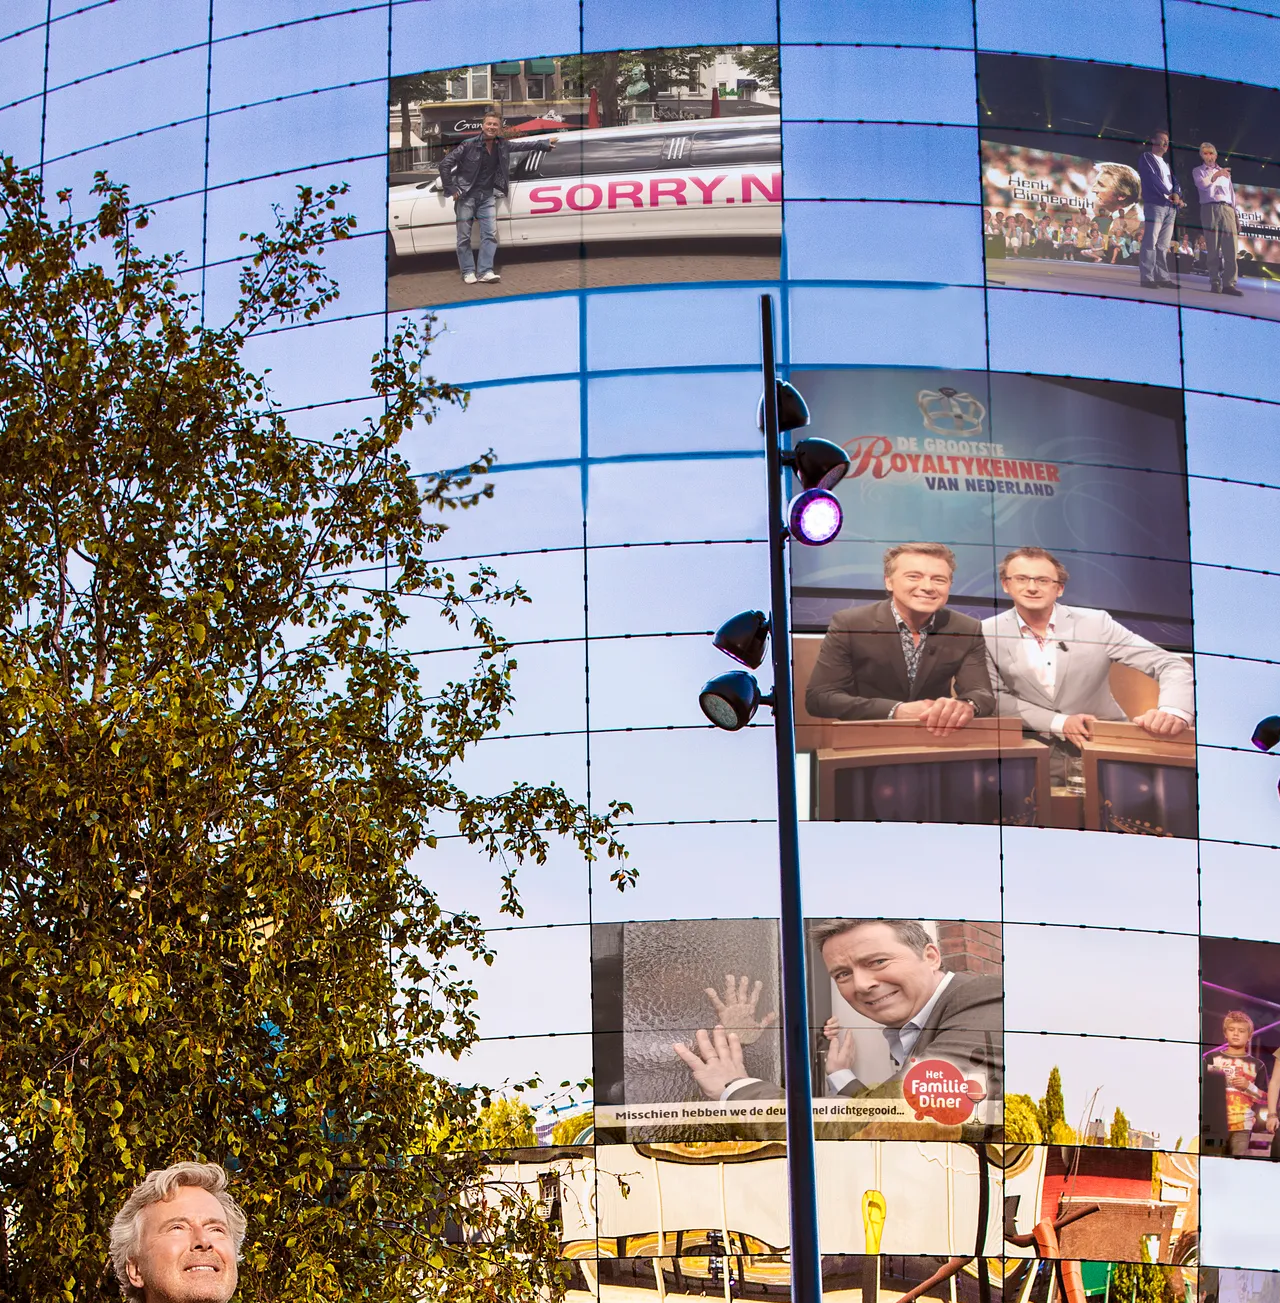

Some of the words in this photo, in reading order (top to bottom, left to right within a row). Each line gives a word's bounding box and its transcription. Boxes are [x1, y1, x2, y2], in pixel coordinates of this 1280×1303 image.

[454, 119, 484, 132] Gran
[1008, 175, 1050, 191] Henk
[528, 172, 782, 215] SORRY.N
[1013, 187, 1095, 210] Binnendijk
[896, 436, 919, 451] DE
[923, 437, 1005, 457] GROOTSTE
[924, 476, 960, 492] VAN
[964, 477, 1055, 498] NEDERLAND
[925, 1070, 944, 1079] Het
[911, 1079, 969, 1095] Familie
[919, 1094, 962, 1109] Diner
[615, 1109, 679, 1120] Misschien
[682, 1107, 727, 1118] hebben
[730, 1107, 747, 1117] we
[749, 1106, 763, 1116] de
[765, 1106, 786, 1116] deu
[812, 1105, 828, 1115] nel
[830, 1105, 905, 1117] dichtgegooid...
